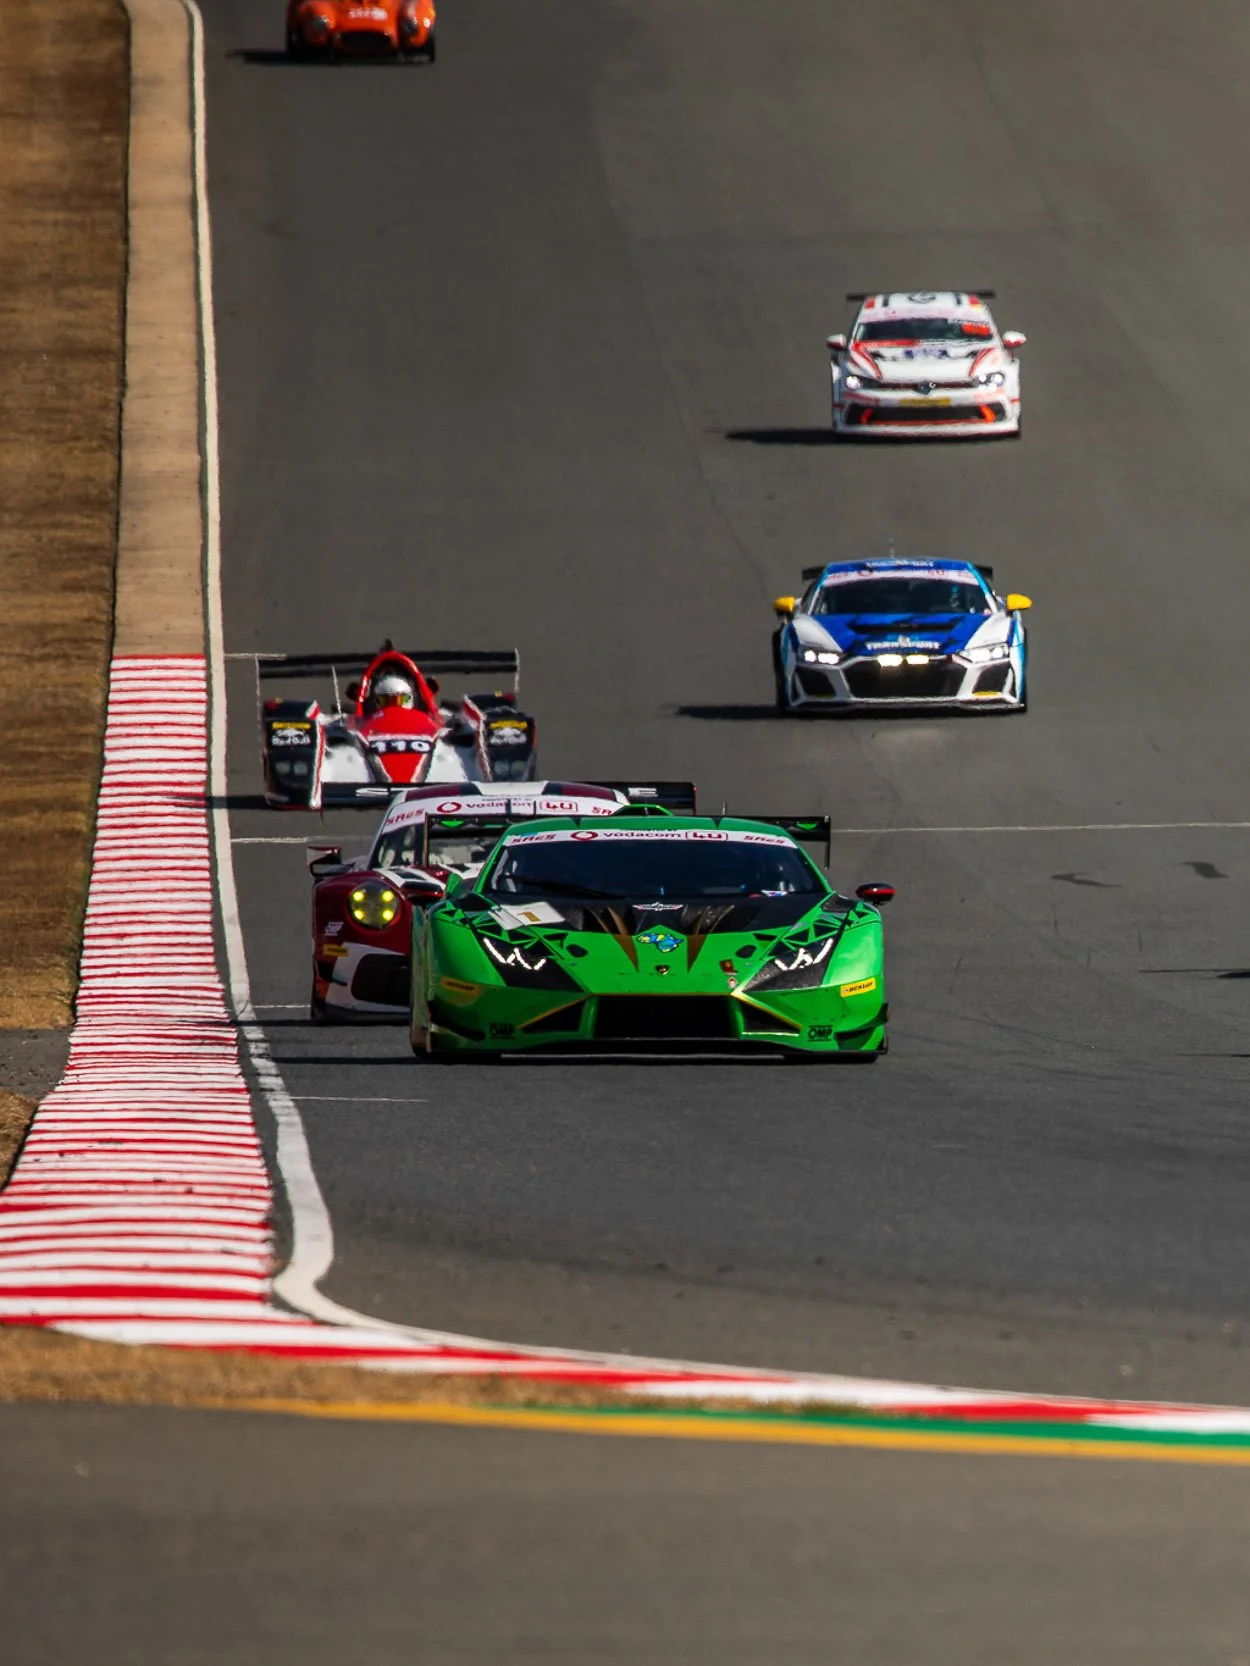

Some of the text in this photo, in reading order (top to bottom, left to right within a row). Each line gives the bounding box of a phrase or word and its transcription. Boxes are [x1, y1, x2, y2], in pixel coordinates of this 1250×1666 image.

[371, 741, 431, 753] 110
[603, 831, 681, 839] vodacom
[517, 911, 541, 922] 1
[808, 1027, 833, 1040] OMP
